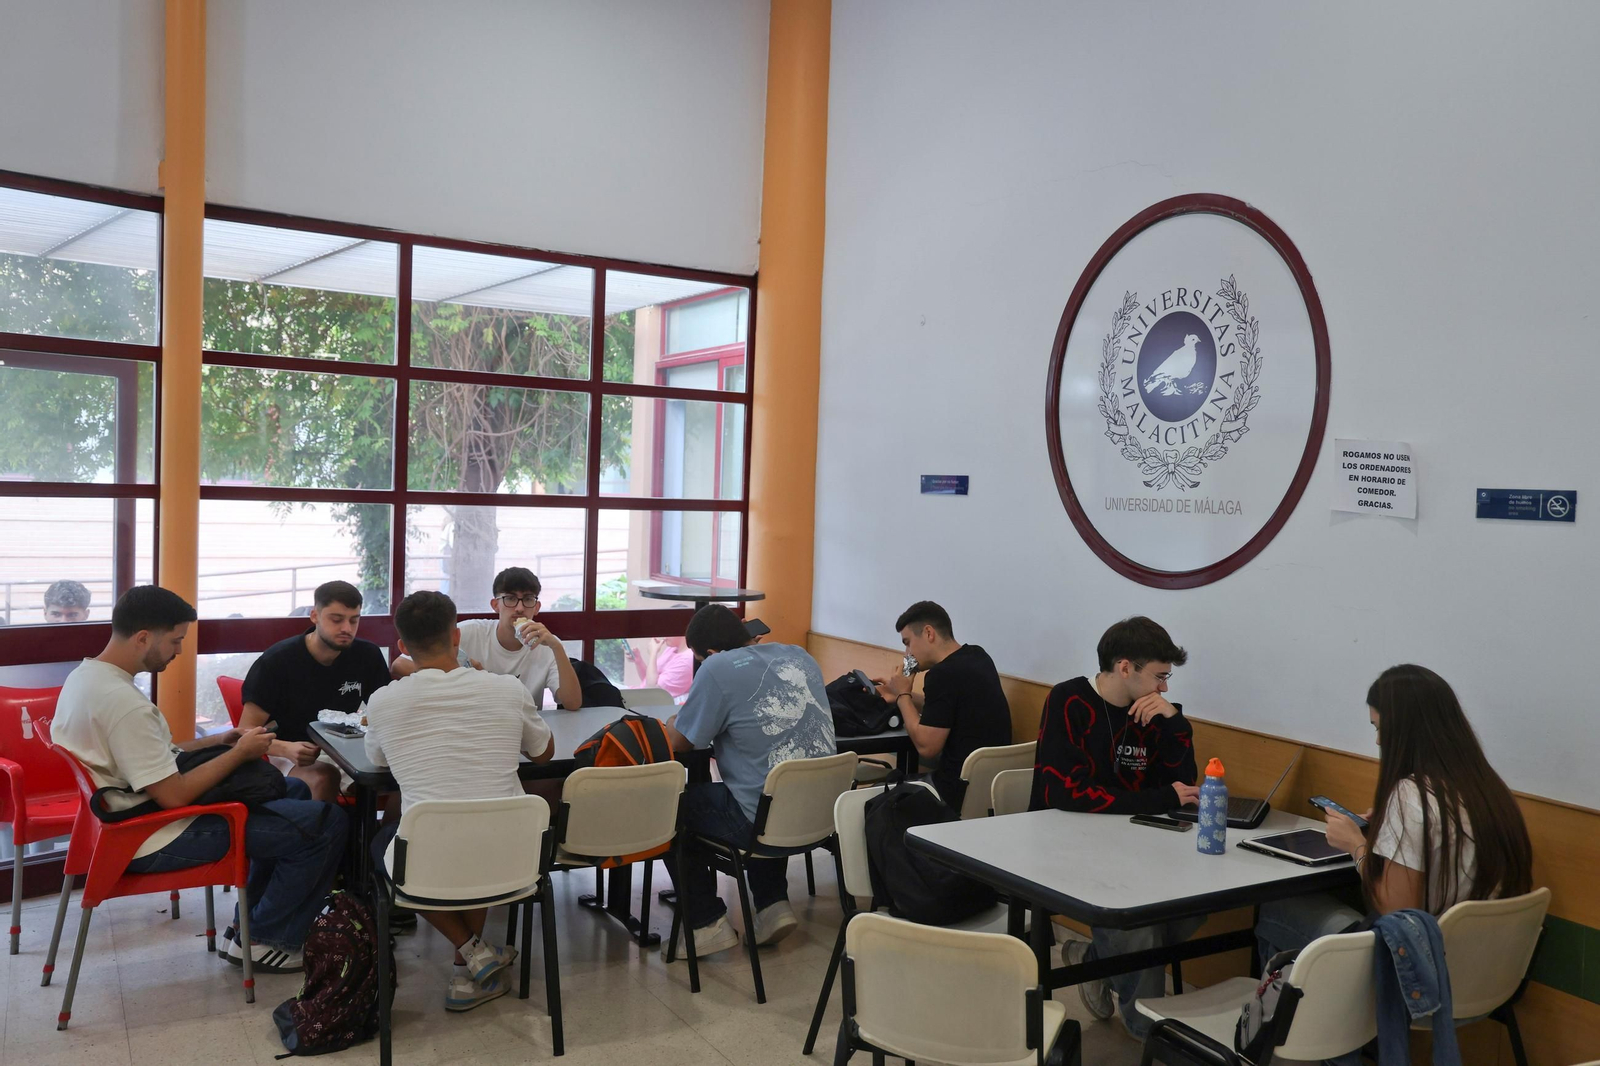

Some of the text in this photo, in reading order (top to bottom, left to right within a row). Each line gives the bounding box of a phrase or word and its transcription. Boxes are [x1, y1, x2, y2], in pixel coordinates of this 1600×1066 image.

[1122, 287, 1235, 365] UNIVERSITAS
[1121, 370, 1235, 446] MALACITANA
[1342, 450, 1411, 462] ROGAMOS NO USEN
[1342, 462, 1412, 474] LOS ORDENADORES
[1348, 474, 1406, 486] EN HORARIO DE
[1357, 486, 1397, 497] COMEDOR.
[1104, 496, 1243, 515] UNIVERSIDAD DE MÁLAGA
[1357, 499, 1394, 510] GRACIAS.
